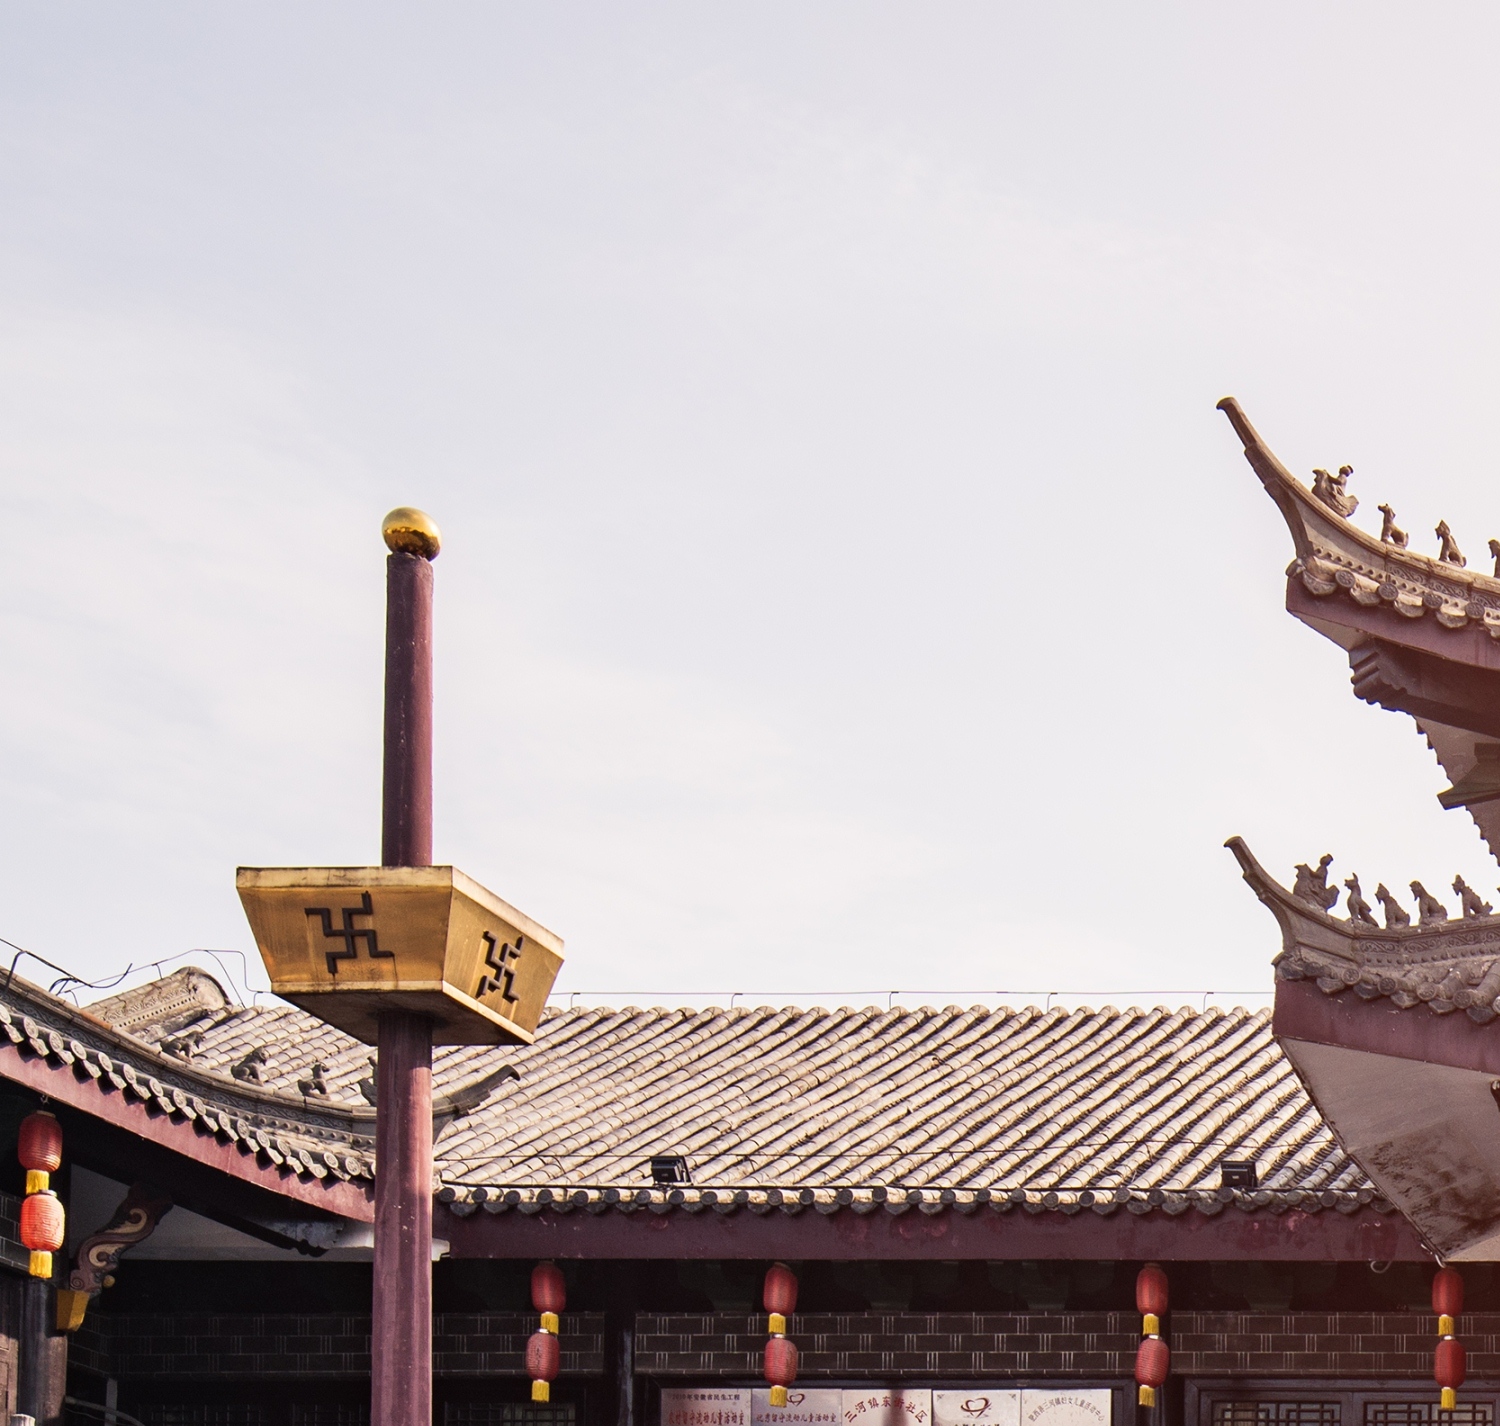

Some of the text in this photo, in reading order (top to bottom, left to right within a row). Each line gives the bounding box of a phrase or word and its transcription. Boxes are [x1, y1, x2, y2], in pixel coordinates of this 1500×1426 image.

[844, 1396, 929, 1423] 三河镇东街社区
